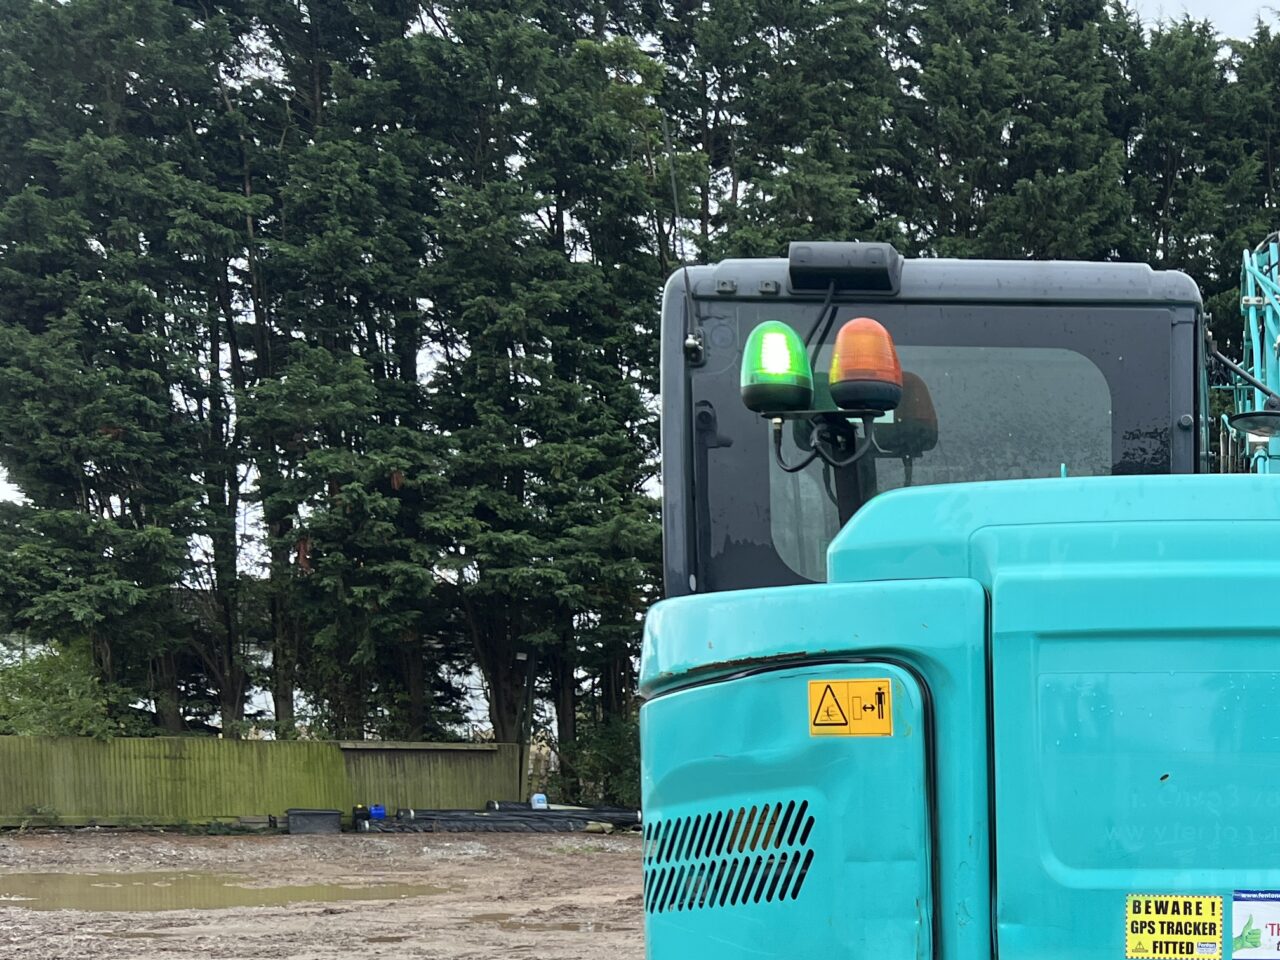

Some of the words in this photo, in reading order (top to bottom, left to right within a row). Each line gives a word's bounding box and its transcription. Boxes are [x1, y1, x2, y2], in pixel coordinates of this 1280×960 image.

[1132, 899, 1203, 916] BEWARE
[1130, 920, 1156, 935] GPS
[1158, 921, 1217, 936] TRACKER
[1152, 940, 1195, 955] FITTED
